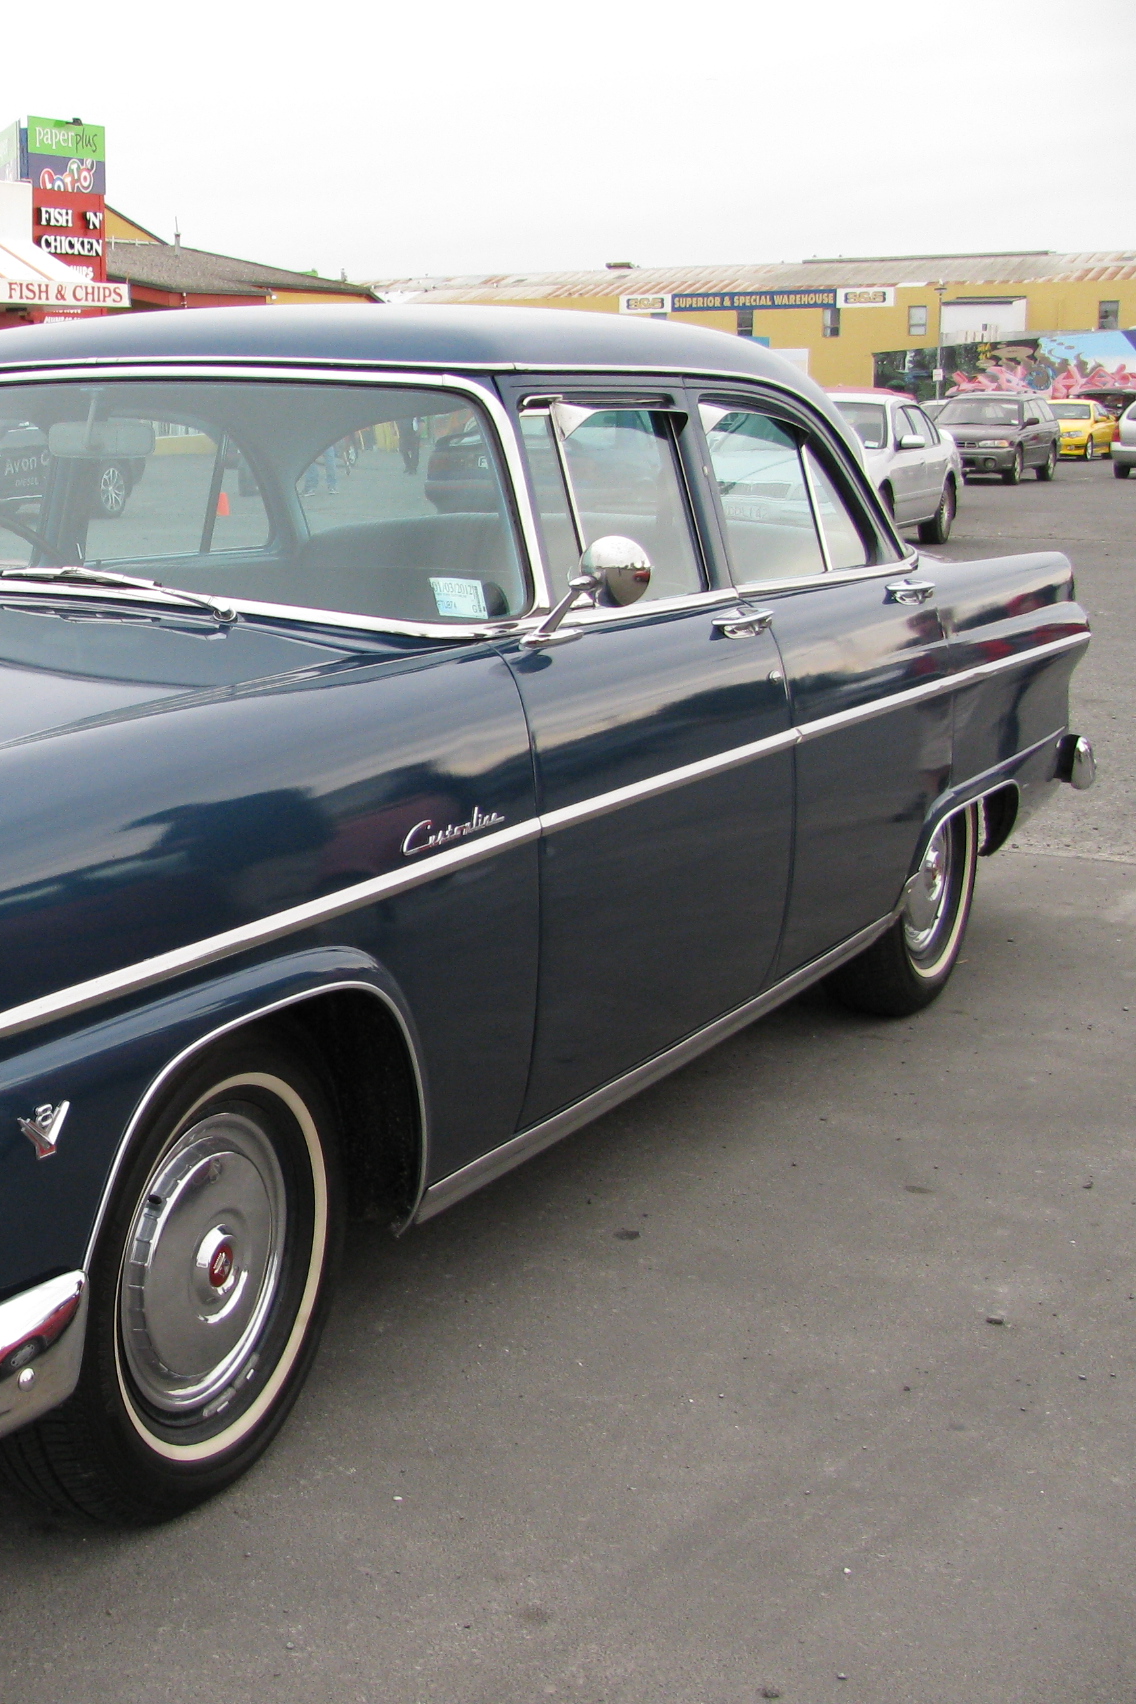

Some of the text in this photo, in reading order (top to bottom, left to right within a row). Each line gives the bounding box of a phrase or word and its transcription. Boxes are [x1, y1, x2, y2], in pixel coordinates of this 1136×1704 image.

[40, 207, 73, 228] FISH
[41, 234, 103, 257] CHICKEN
[8, 282, 123, 303] FISH & CHIPS
[674, 292, 834, 308] SUPERIOR & SPECIAL WAREHOUSE
[402, 806, 505, 856] Customline
